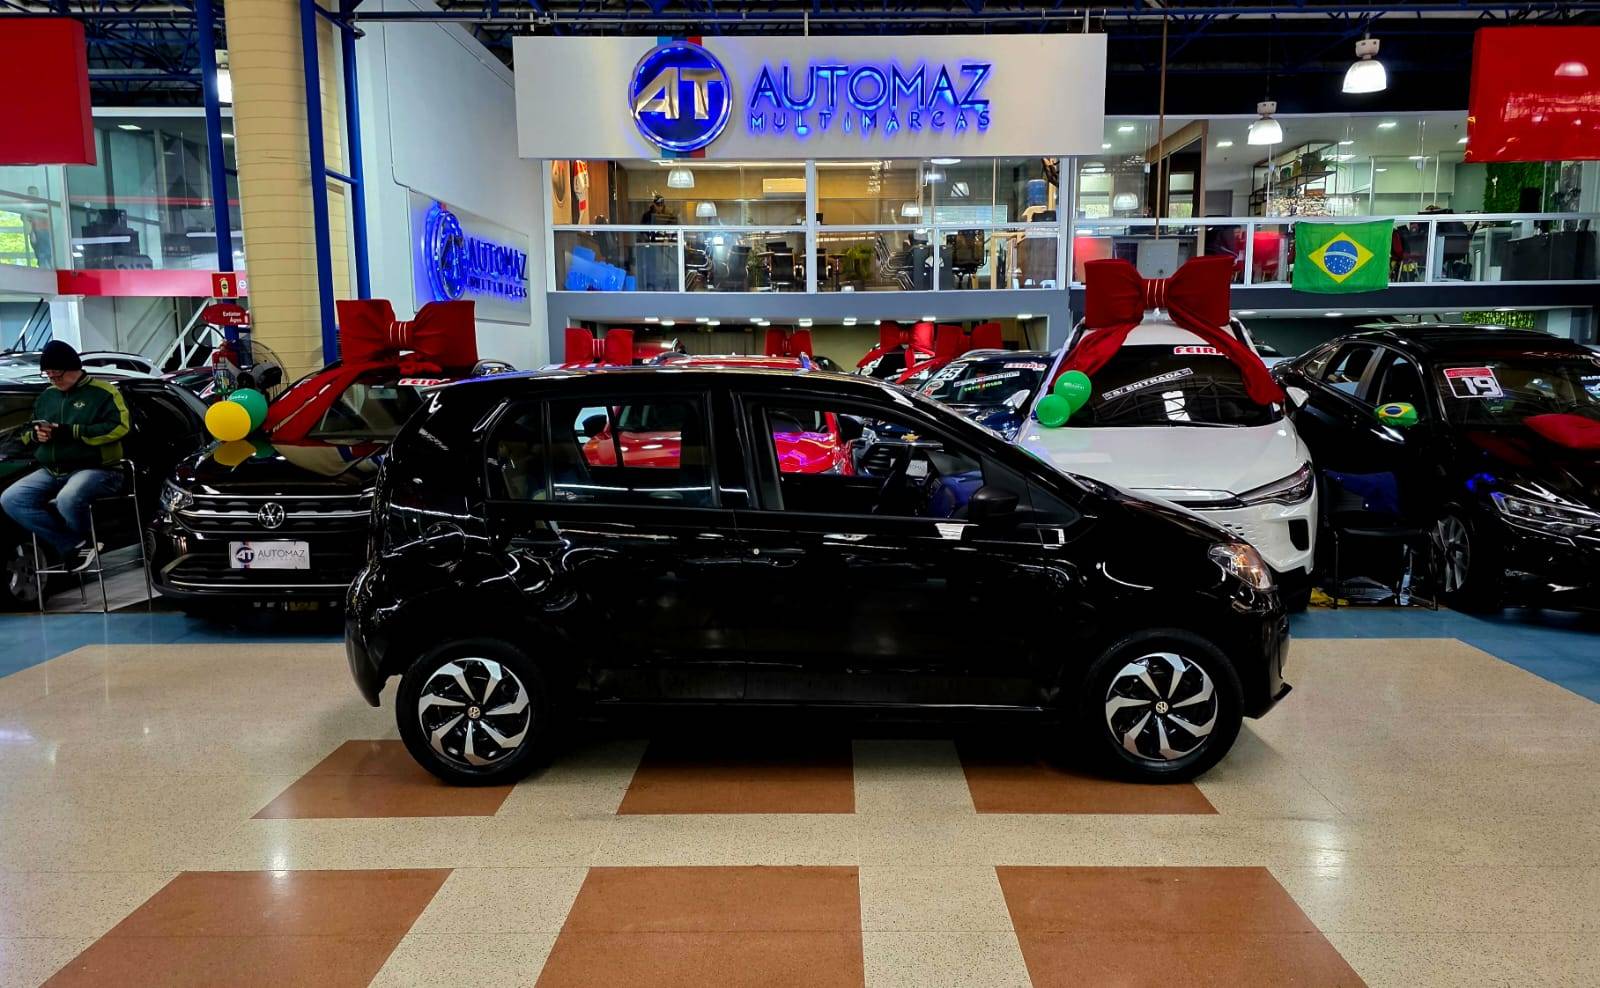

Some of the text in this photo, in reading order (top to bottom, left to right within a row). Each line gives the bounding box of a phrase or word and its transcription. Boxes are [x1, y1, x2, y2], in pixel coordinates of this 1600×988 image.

[634, 66, 722, 119] AT
[750, 64, 992, 110] AUTOMAZ
[750, 111, 991, 131] MULTIMARCAS
[466, 237, 528, 281] AUTOMAZ
[1126, 371, 1181, 392] ENTRADA
[1461, 377, 1500, 397] 19
[258, 549, 305, 558] AUTOMAZ
